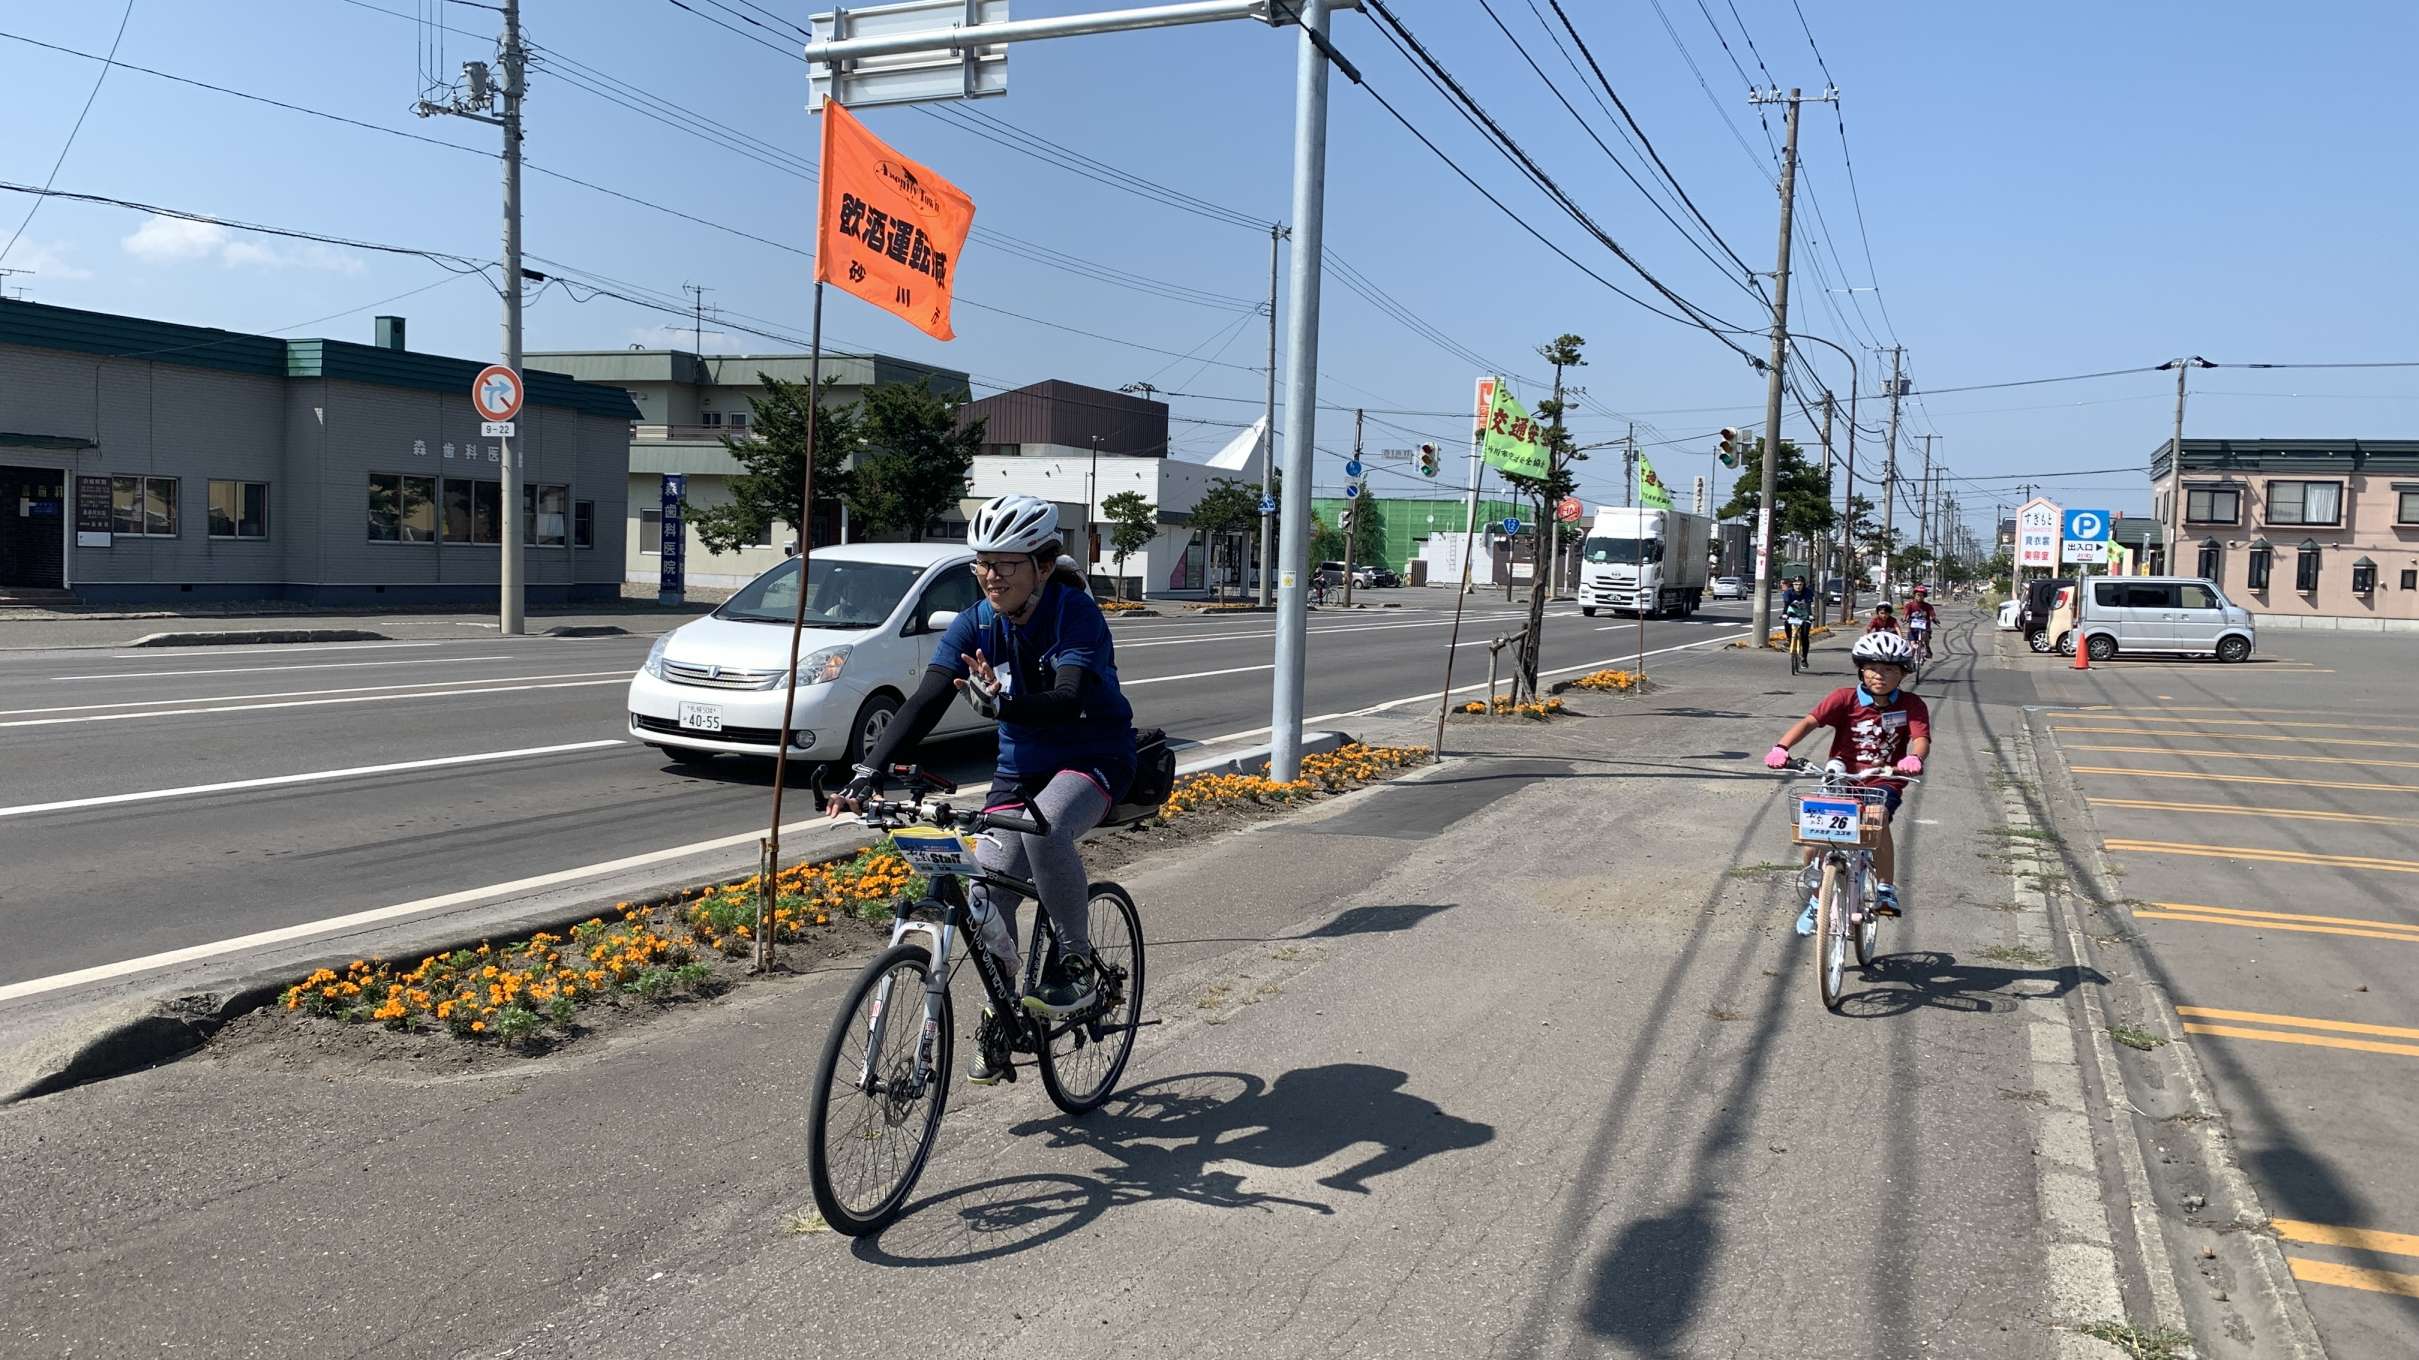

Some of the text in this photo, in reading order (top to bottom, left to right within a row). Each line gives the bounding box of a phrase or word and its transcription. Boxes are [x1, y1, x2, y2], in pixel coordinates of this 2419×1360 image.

[486, 425, 510, 434] 9-22
[413, 440, 523, 468] 森歯科医
[2024, 512, 2052, 526] すぎもと
[2079, 517, 2096, 535] P
[663, 481, 678, 575] 森歯科医院
[2067, 543, 2093, 551] 出入口
[689, 713, 720, 729] 40-55
[1829, 816, 1849, 830] 26
